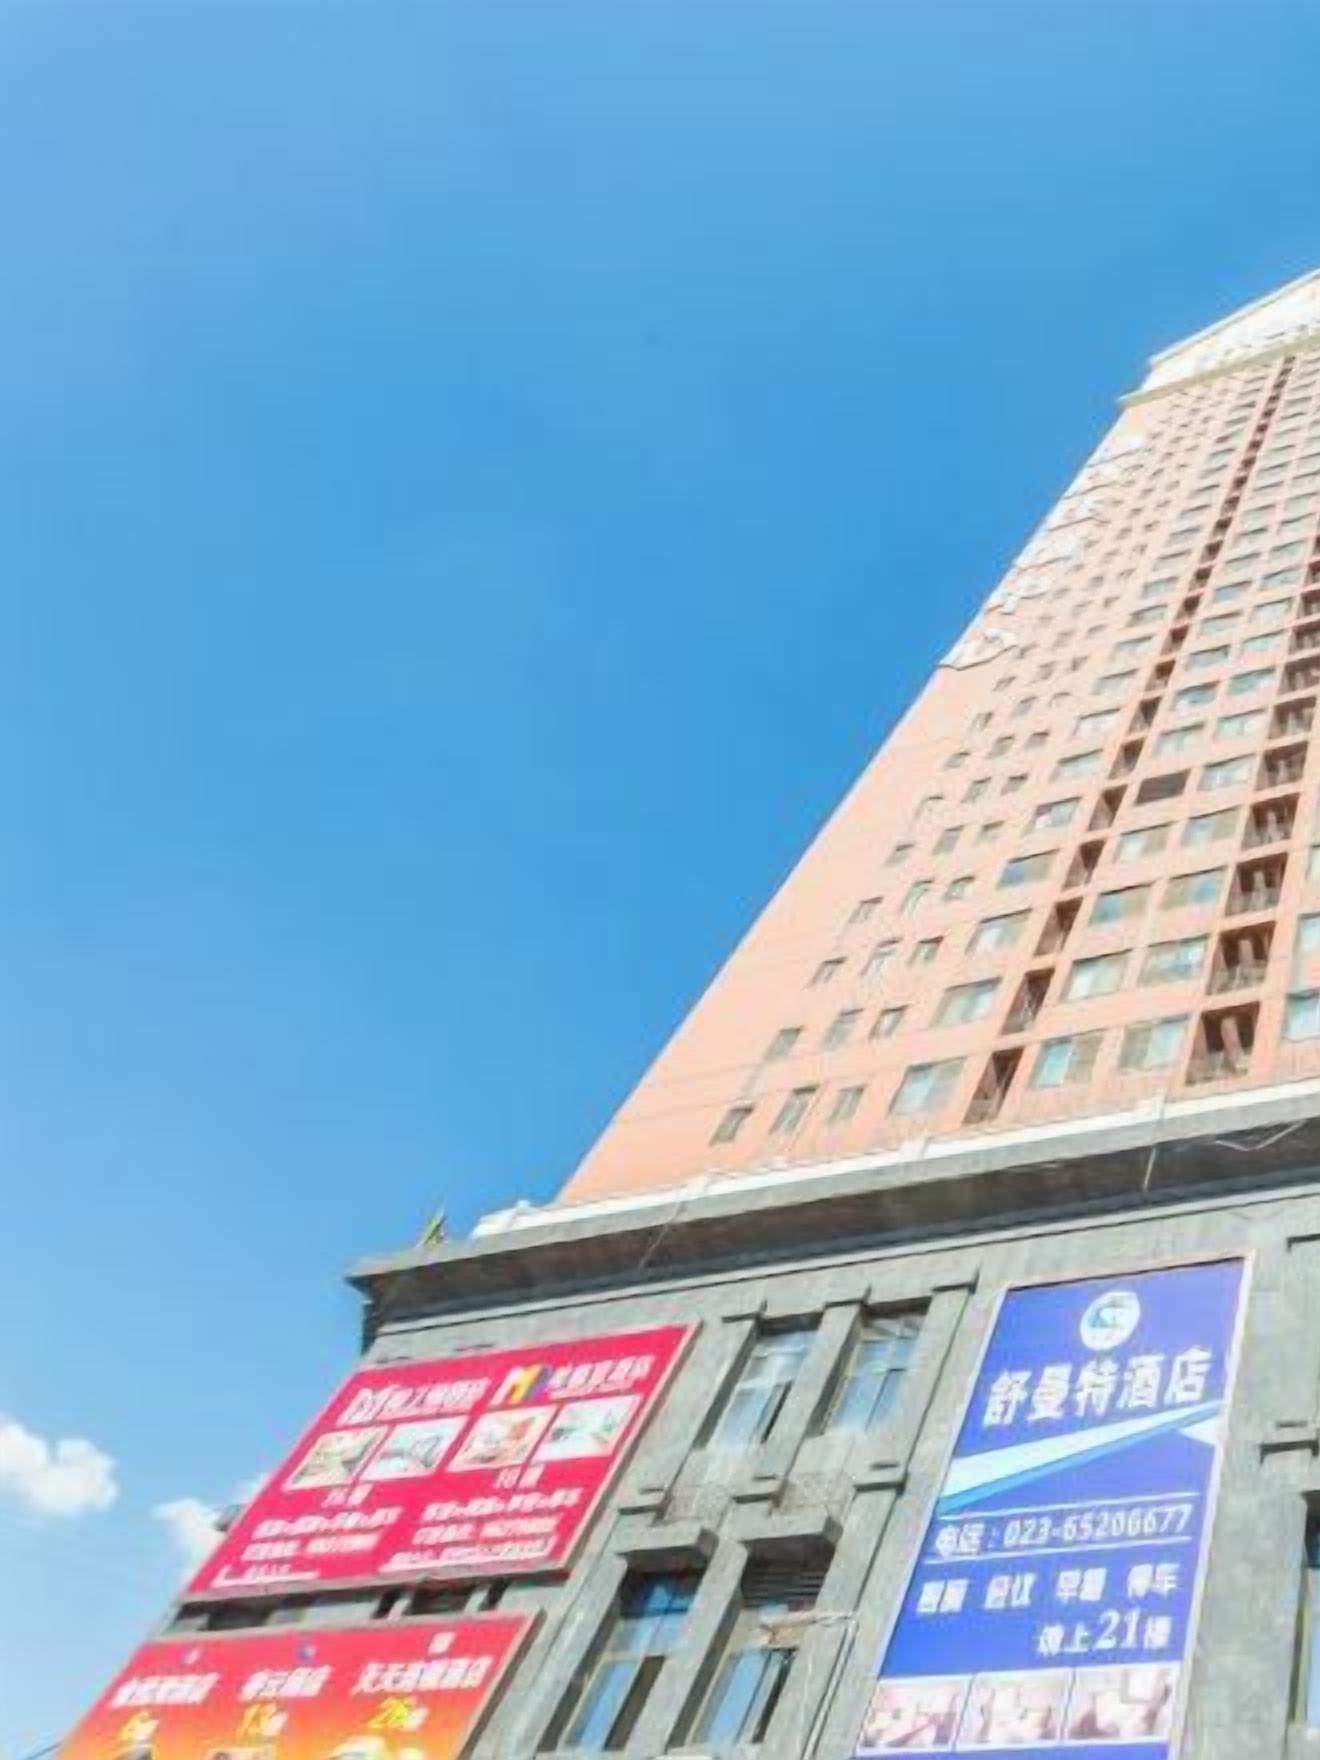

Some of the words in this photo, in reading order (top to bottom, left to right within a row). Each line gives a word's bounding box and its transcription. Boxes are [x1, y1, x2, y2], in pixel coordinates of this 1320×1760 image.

[983, 1345, 1212, 1427] 舒曼特酒店
